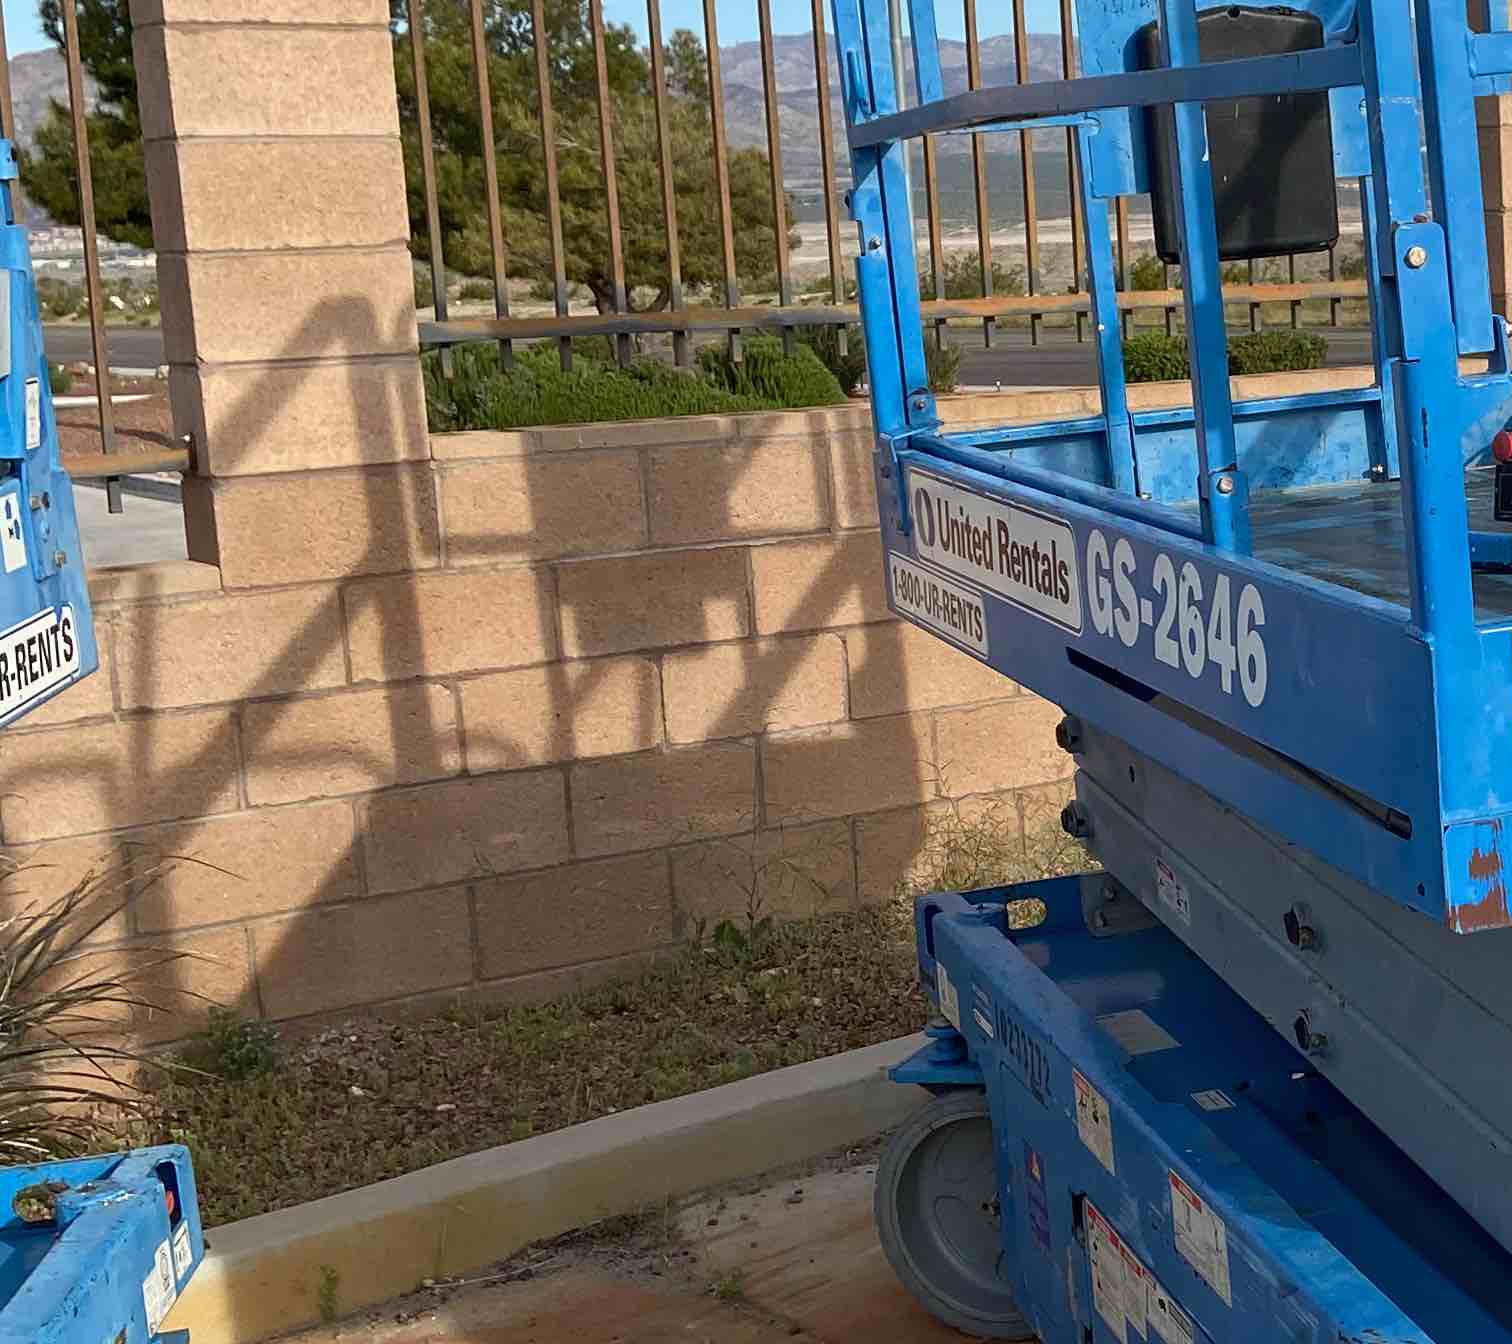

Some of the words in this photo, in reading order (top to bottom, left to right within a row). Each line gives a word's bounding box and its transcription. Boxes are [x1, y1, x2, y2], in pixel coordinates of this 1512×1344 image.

[936, 499, 994, 570] United
[996, 518, 1070, 605] Rentals
[892, 565, 984, 642] 1-800-UR-RENTS
[1087, 528, 1267, 708] GS-2646
[0, 617, 74, 701] R-RENTS
